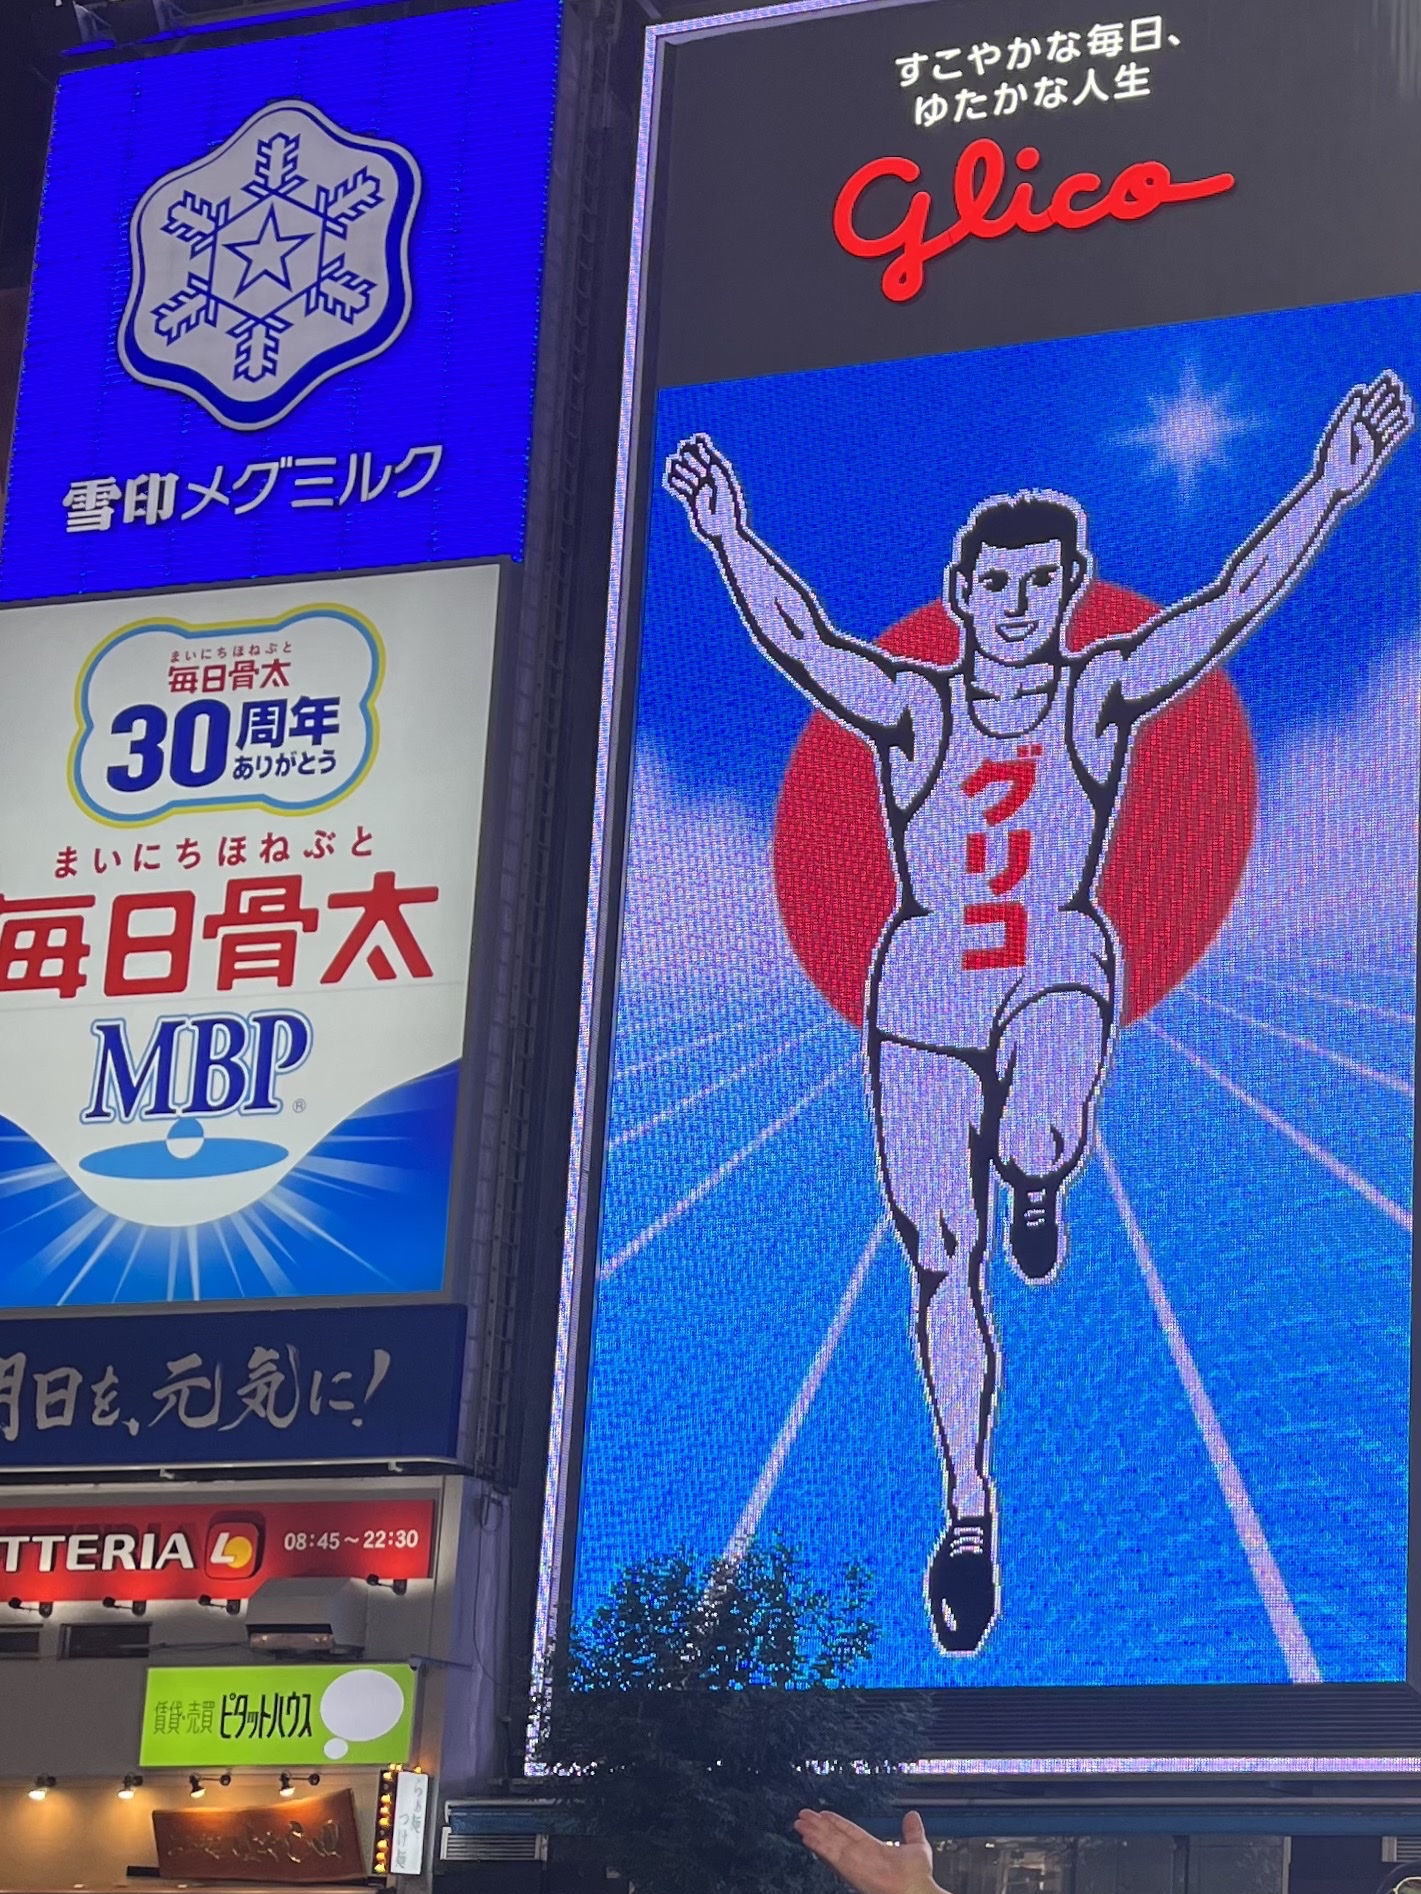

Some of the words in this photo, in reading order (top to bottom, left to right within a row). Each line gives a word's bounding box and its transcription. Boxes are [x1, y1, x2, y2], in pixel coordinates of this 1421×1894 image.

[895, 15, 1182, 88] すこやかな毎日、
[914, 63, 1152, 128] ゆたかな人生
[833, 138, 1235, 303] Glico
[61, 444, 443, 533] 雪印メグミルク
[168, 659, 291, 694] 毎日骨太
[170, 641, 292, 662] まいにちほねぶと
[232, 749, 338, 781] ありがとう
[53, 826, 374, 879] まいにちほねぶと
[961, 743, 1043, 970] グリコ
[83, 1010, 312, 1124] MBP
[219, 1691, 313, 1739] ピタットハウス
